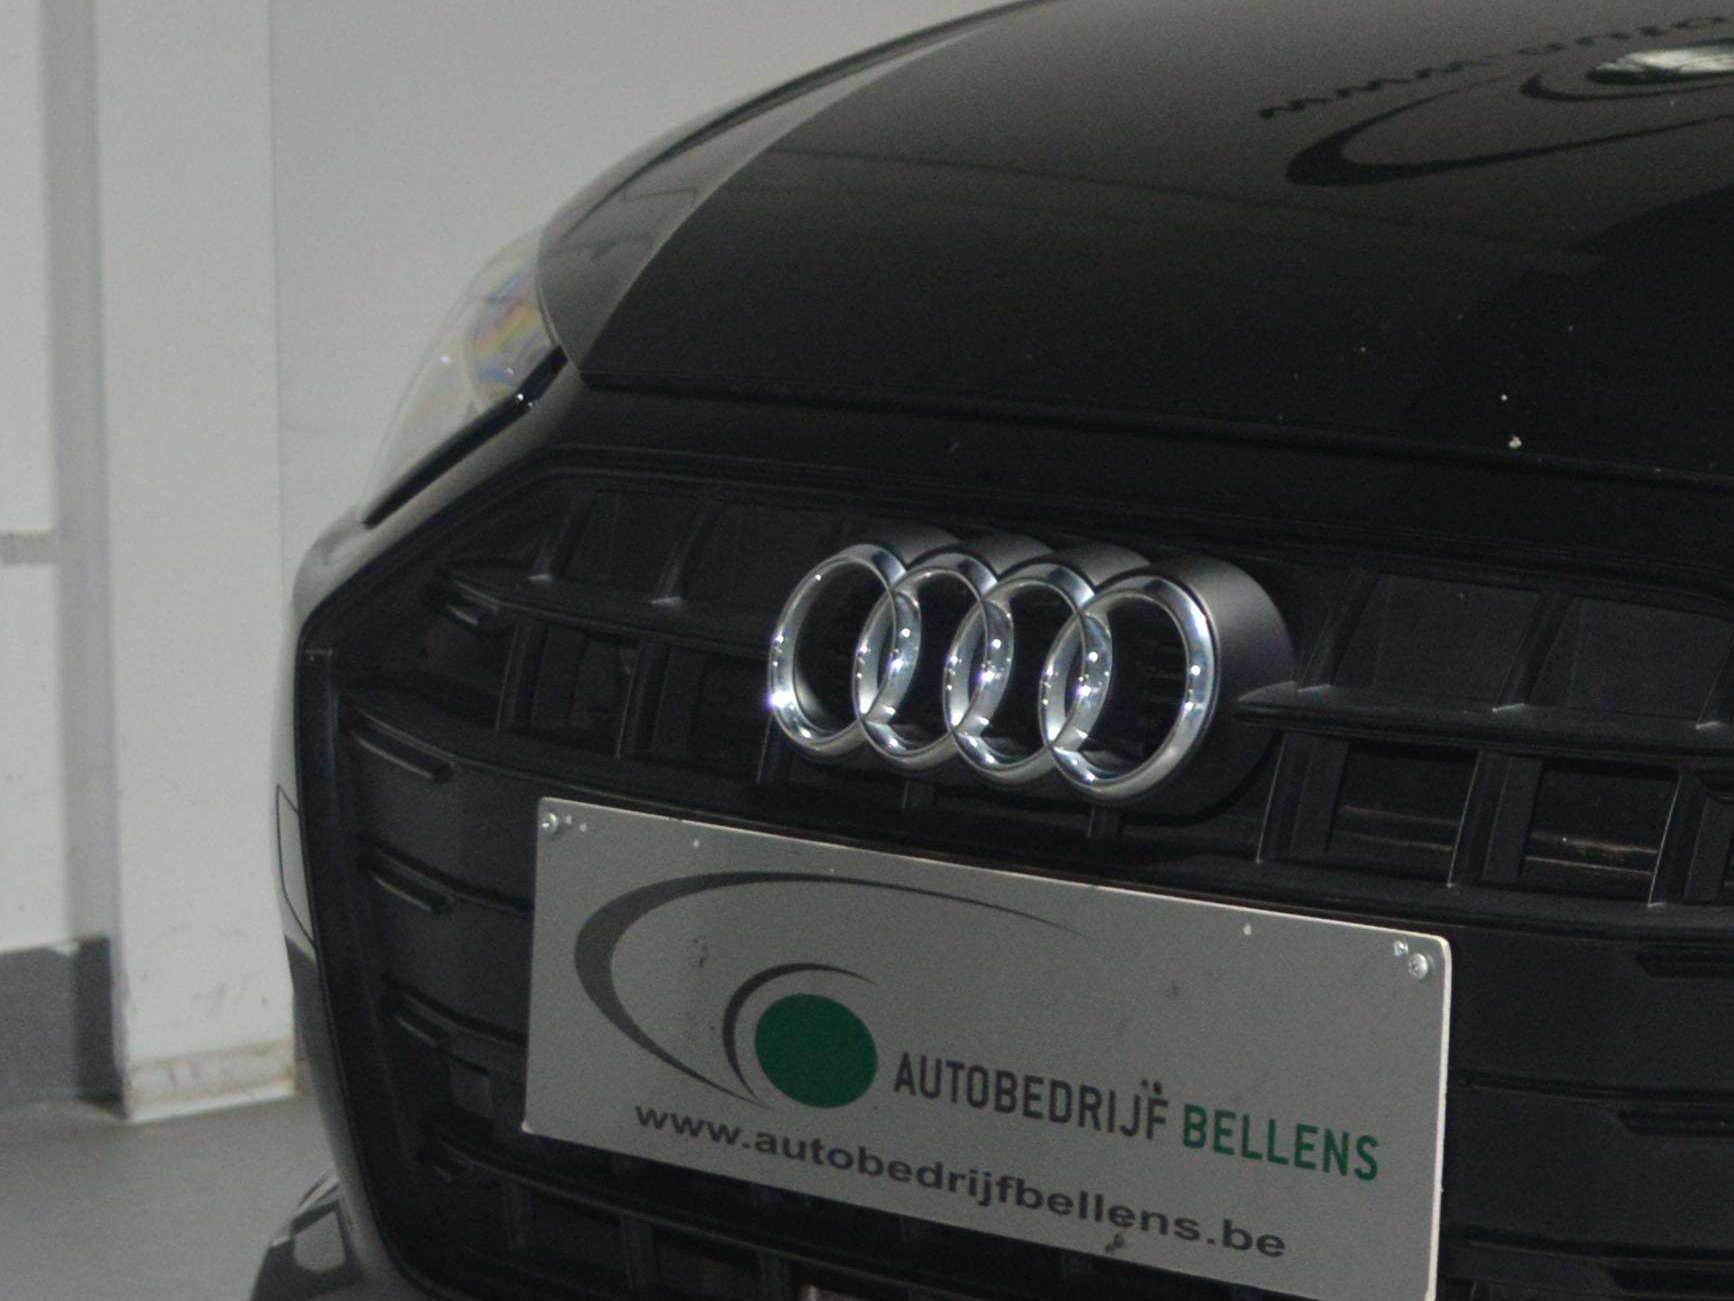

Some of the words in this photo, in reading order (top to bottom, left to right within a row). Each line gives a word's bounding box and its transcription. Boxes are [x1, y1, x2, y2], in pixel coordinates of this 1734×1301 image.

[635, 1105, 1286, 1258] www.autobedrijfbellens.be
[893, 1052, 1168, 1140] AUTOBEDRIJF
[1182, 1103, 1379, 1181] BELLENS
